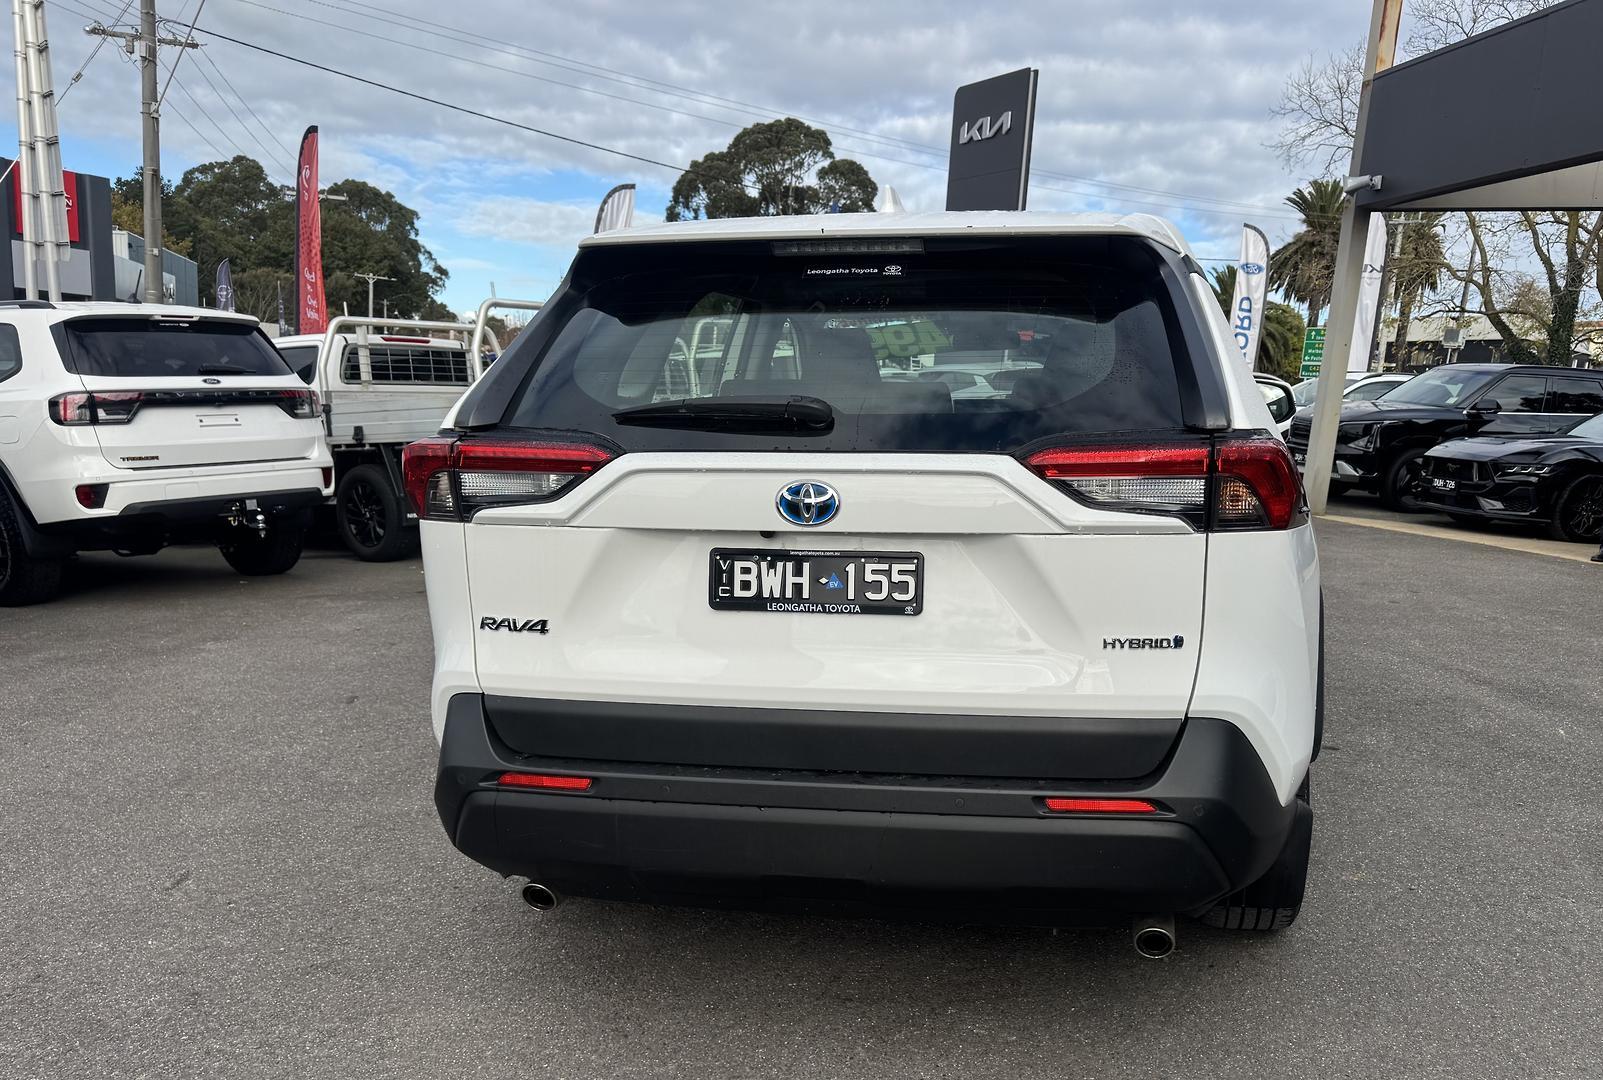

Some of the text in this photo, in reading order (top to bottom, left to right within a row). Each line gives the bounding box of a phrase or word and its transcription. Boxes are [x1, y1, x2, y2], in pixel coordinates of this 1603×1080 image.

[959, 110, 1012, 144] KIA
[718, 559, 731, 597] VIC
[733, 560, 810, 599] BWH
[845, 562, 916, 601] 155
[767, 602, 861, 613] LEONGATHA TOYOTA
[479, 616, 549, 634] RAV4
[1103, 638, 1171, 649] HYBRID
